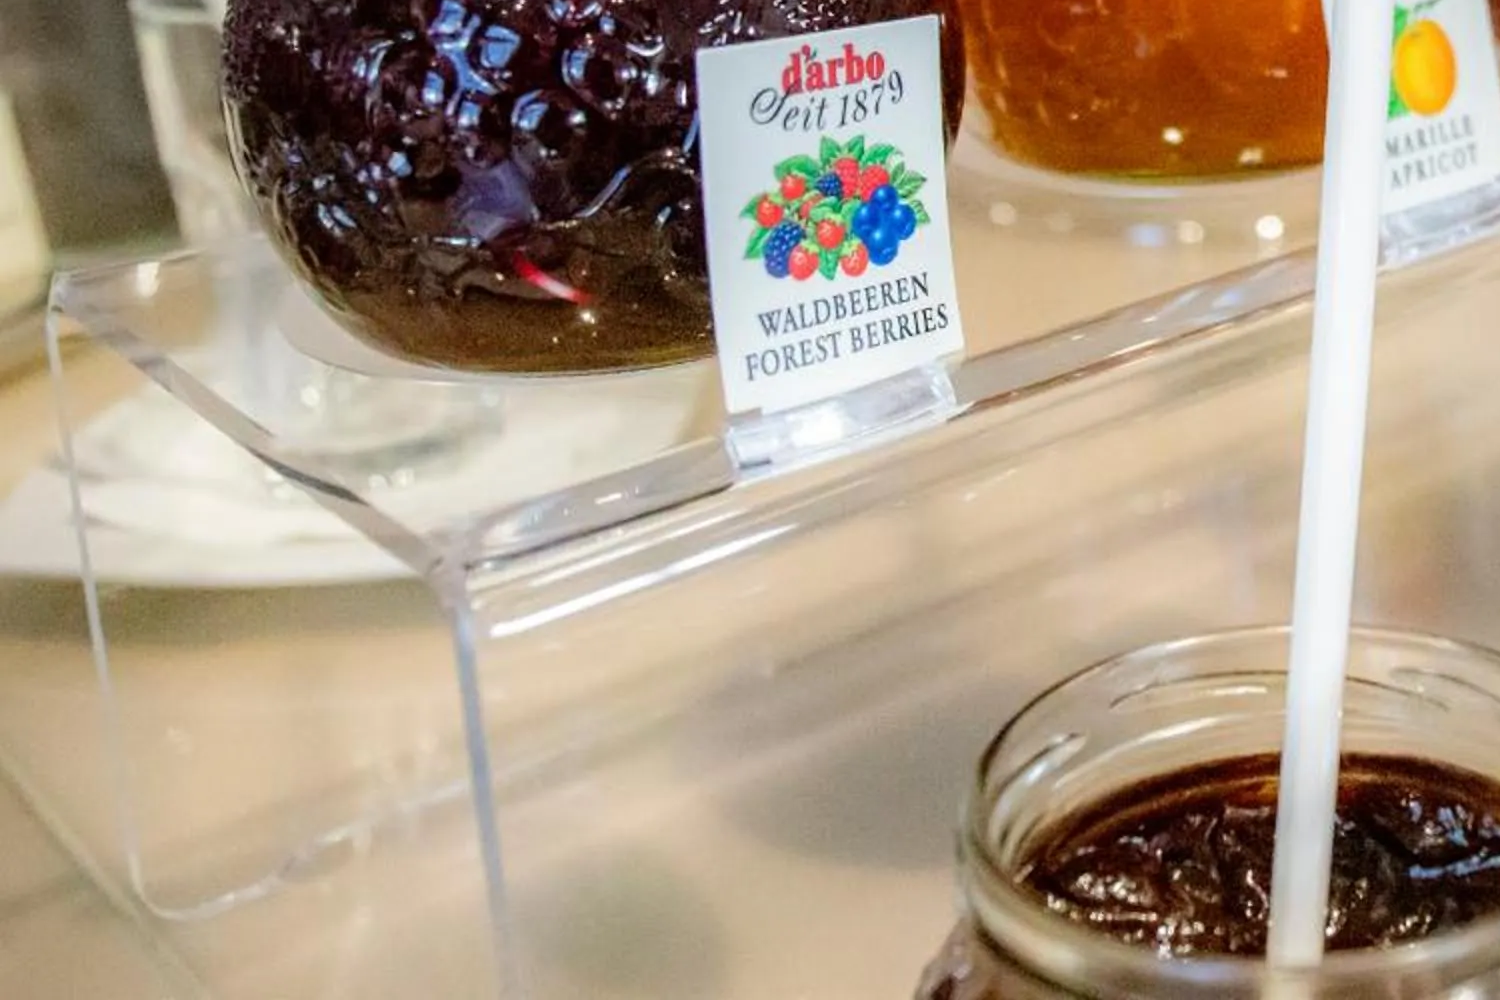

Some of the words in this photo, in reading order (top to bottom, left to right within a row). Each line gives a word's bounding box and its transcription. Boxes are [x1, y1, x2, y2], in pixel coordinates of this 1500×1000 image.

[750, 82, 828, 132] Seit
[838, 70, 904, 128] 1879
[1391, 141, 1477, 189] APRICOT
[758, 272, 930, 338] WALDBEEREN
[745, 331, 842, 382] FOREST
[849, 303, 949, 353] BERRIES
